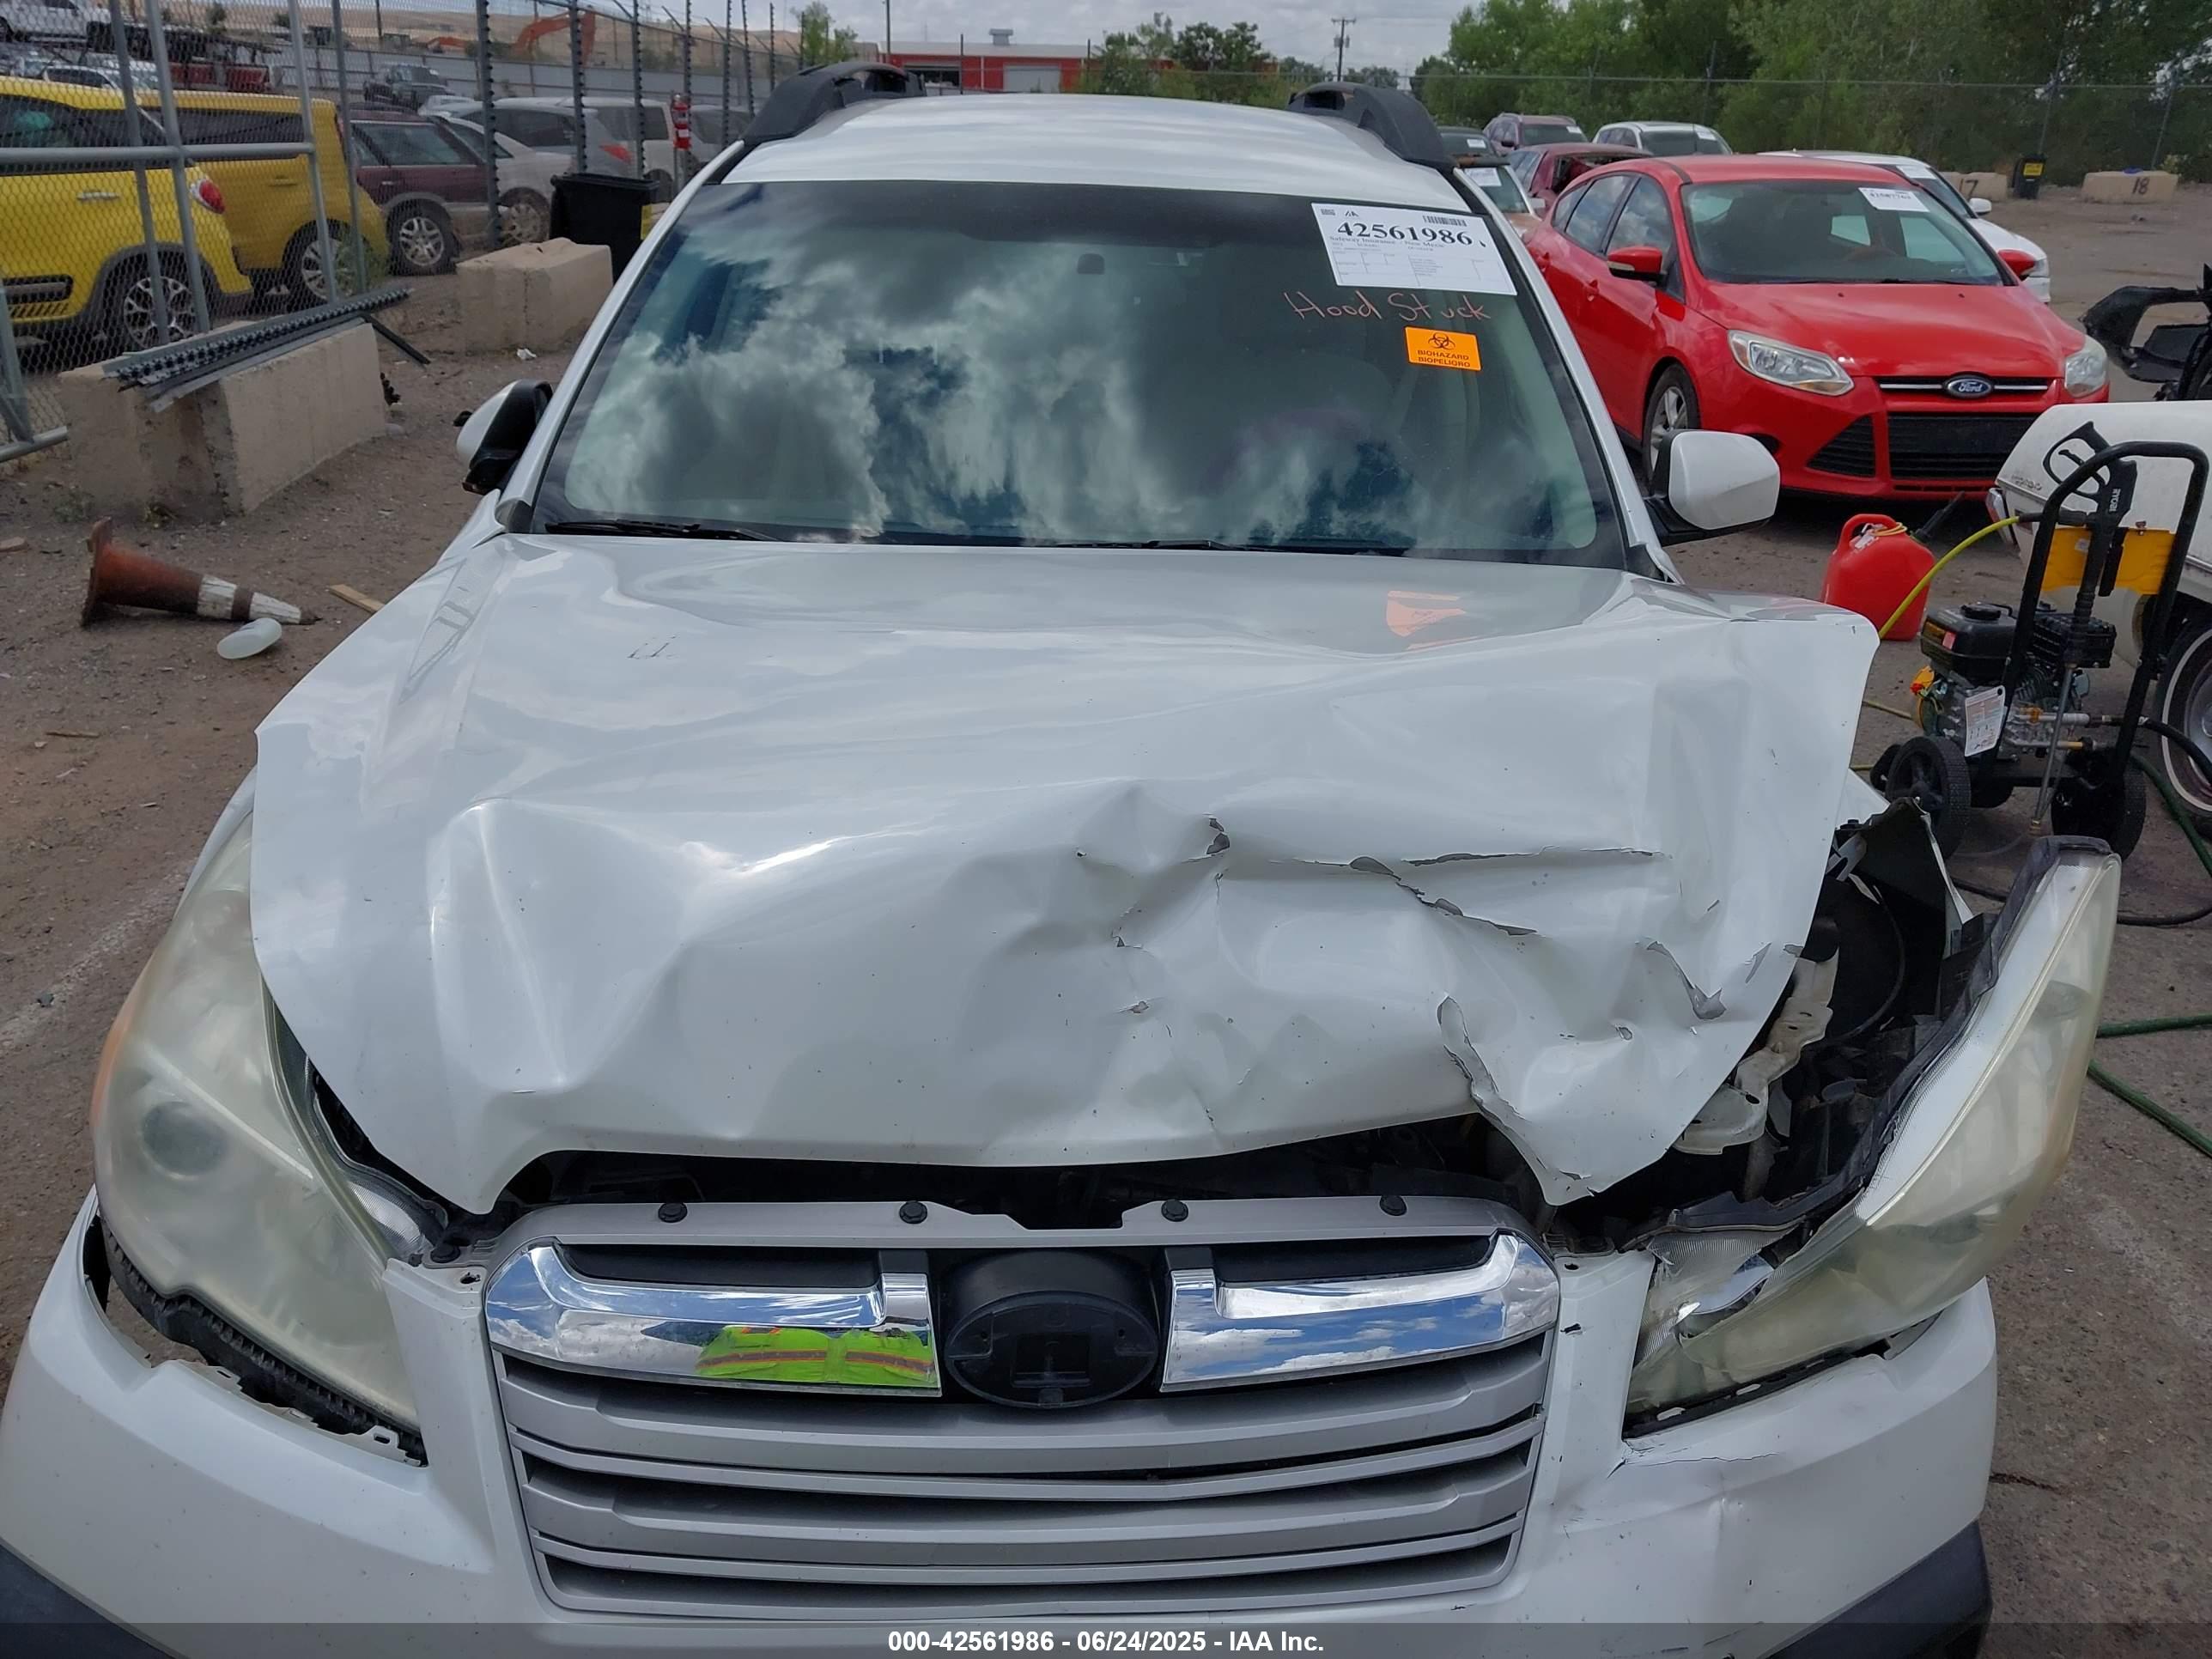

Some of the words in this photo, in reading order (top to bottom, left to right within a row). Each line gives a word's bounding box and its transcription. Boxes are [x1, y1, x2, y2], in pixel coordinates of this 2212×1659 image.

[1959, 178, 1979, 198] 17
[2131, 178, 2150, 195] 18
[1338, 222, 1473, 246] 42561986
[1284, 290, 1382, 319] Hood
[1418, 349, 1469, 361] BIOHAZARD
[1419, 356, 1471, 368] BIOPELIGRO
[1958, 381, 1983, 392] Ford
[2109, 488, 2121, 512] RYOBI
